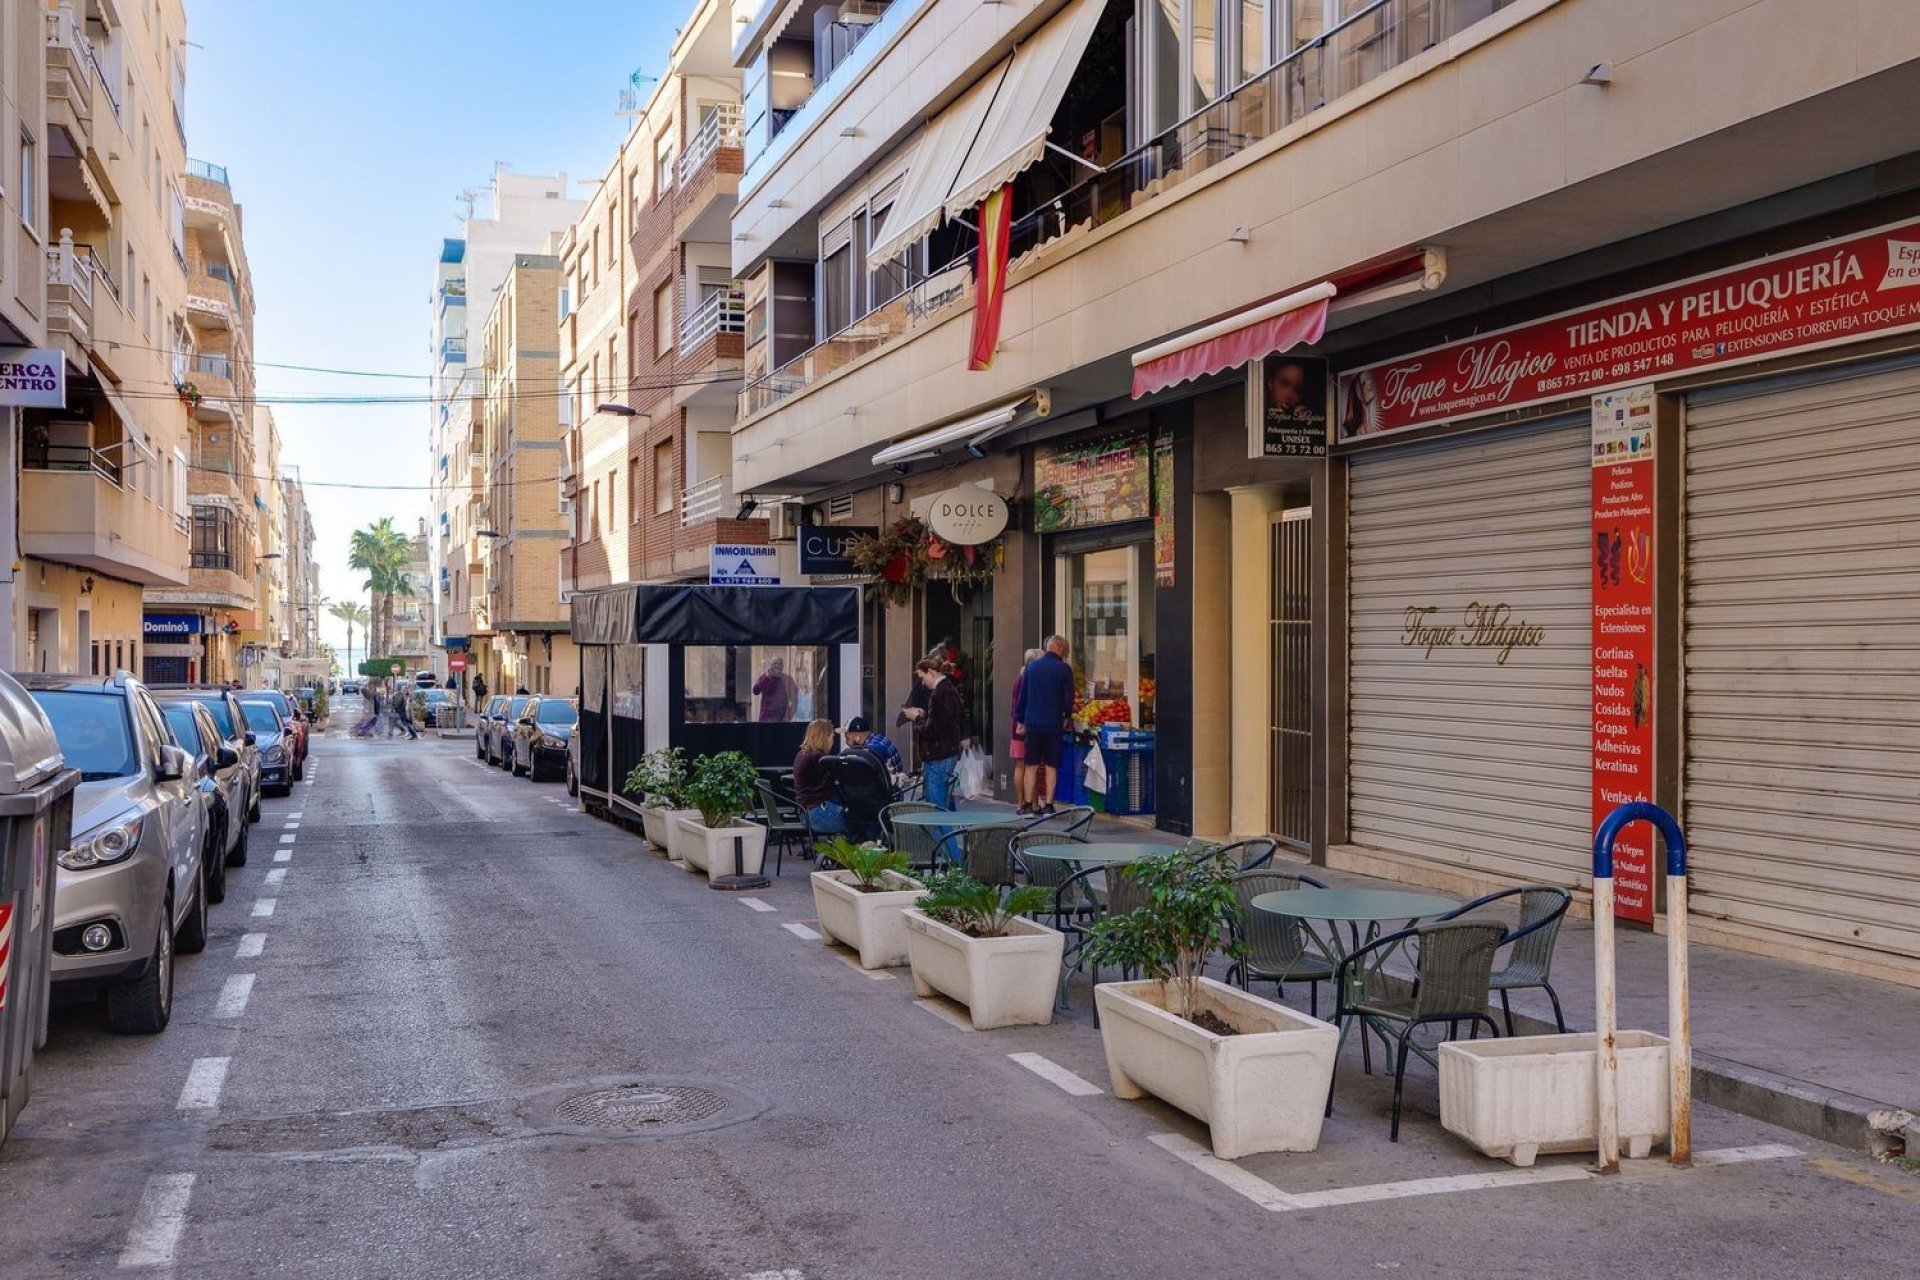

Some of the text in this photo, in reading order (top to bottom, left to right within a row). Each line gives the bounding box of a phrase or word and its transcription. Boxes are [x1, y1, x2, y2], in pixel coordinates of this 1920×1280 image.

[1887, 267, 1904, 278] en
[1566, 250, 1864, 348] TIENDA Y PELUQUERÍA
[1563, 290, 1869, 370] VENTA DE PRODUCTOS PARA PELUQUERÍA Y ESTÉTICA
[1728, 328, 1794, 353] EXTENSIONES
[1797, 314, 1859, 338] TORREVIEJA
[1862, 304, 1905, 325] TOQUE
[1546, 375, 1563, 390] 865
[1564, 373, 1576, 386] 75
[1578, 371, 1590, 383] 72
[1591, 368, 1604, 381] 00
[1612, 362, 1631, 376] 698
[1633, 357, 1652, 372] 547
[1655, 352, 1674, 367] 148
[1381, 340, 1557, 417] Toque Mágico
[1419, 391, 1496, 415] www.toquemagico.es
[1282, 435, 1311, 444] UNISEX
[1285, 444, 1297, 454] 75
[1300, 445, 1311, 454] 72
[1313, 446, 1325, 455] 00
[1612, 466, 1633, 476] Pelucas
[1610, 481, 1634, 490] Postizos
[1602, 492, 1643, 505] Productos Afro
[943, 504, 994, 517] DOLCE
[1594, 509, 1619, 519] Producto
[715, 547, 777, 556] INMOBILIARIA
[1595, 604, 1652, 620] Especialista en
[144, 621, 190, 632] Domino's
[1402, 605, 1457, 660] Toque
[1600, 622, 1646, 633] Extensiones
[1595, 647, 1634, 660] Cortinas
[1595, 665, 1628, 678] Sueltas
[1595, 684, 1625, 697] Nudos
[1595, 703, 1631, 716] Cosidas
[1595, 721, 1628, 737] Grapas
[1595, 740, 1641, 755] Adhesivas
[1595, 758, 1638, 773] Keratinas
[1600, 788, 1633, 804] Ventas
[1622, 844, 1645, 858] Virgen
[1620, 861, 1646, 874] Natural
[1617, 894, 1643, 908] Natural
